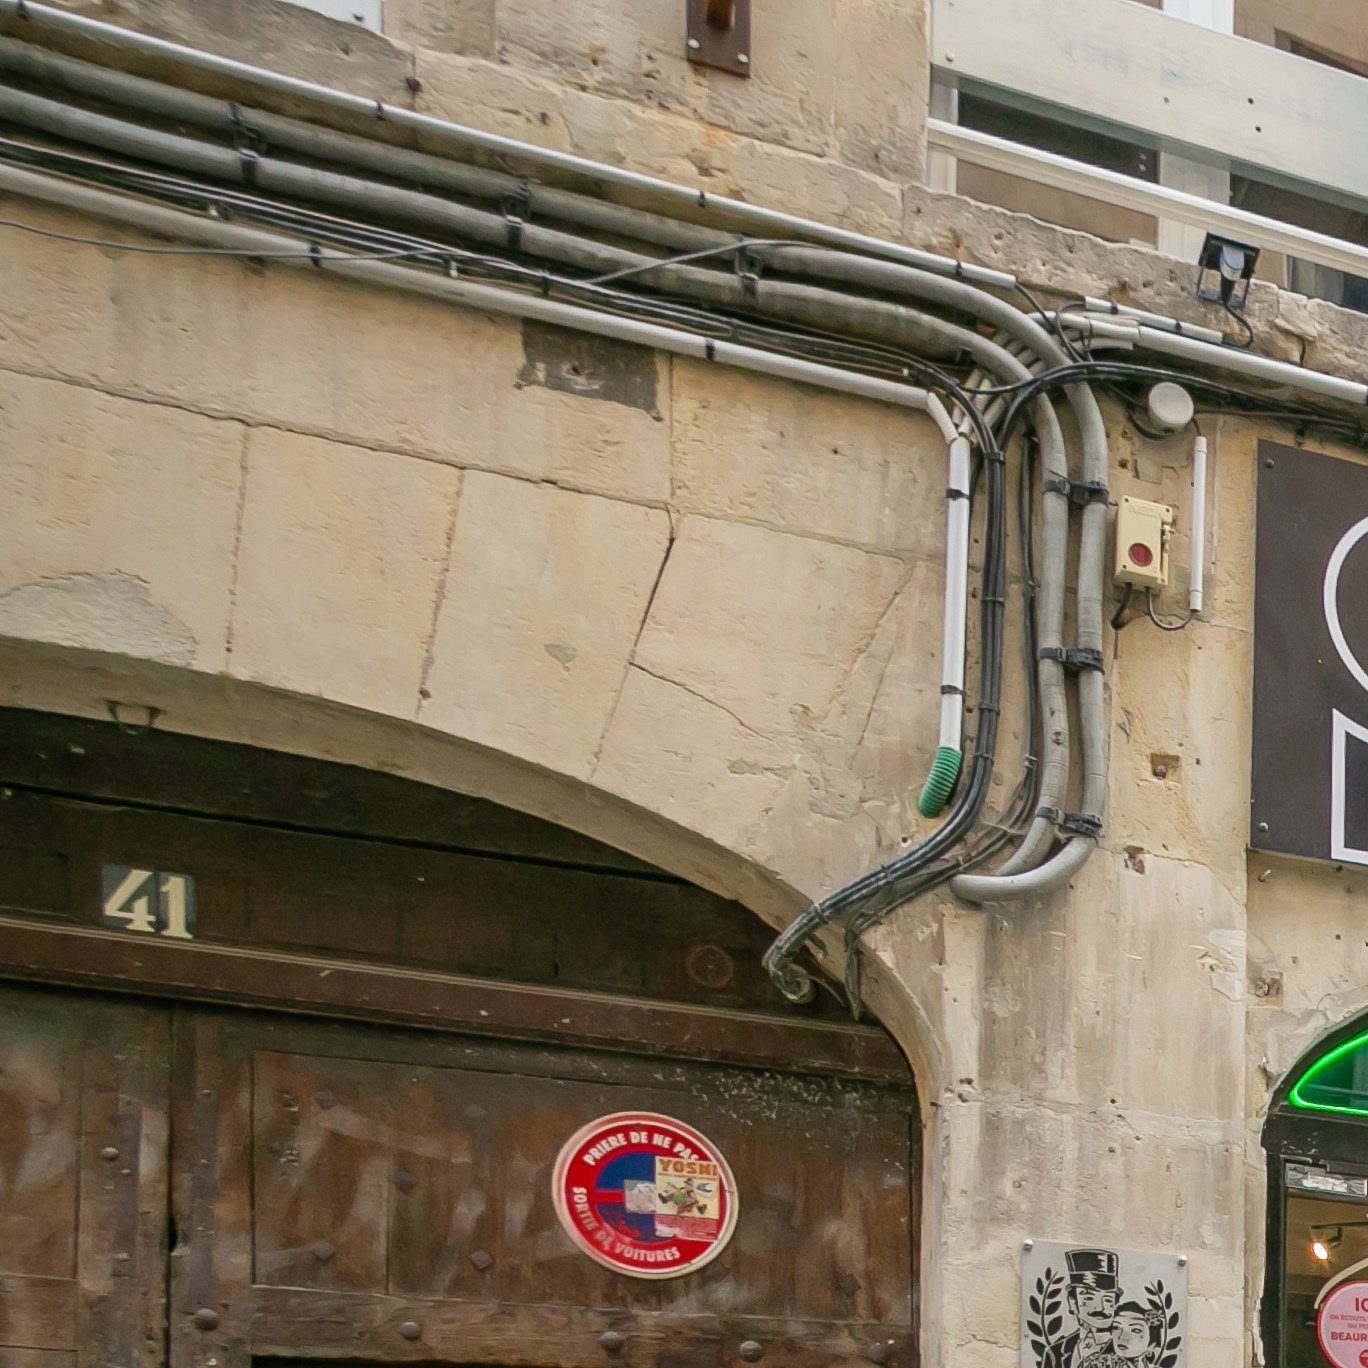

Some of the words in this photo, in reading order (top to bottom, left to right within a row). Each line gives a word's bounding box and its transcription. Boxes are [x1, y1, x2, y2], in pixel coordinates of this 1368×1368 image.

[103, 869, 193, 939] 41
[582, 1132, 628, 1167] PRIERE
[629, 1131, 649, 1144] DE
[652, 1133, 671, 1149] NE
[615, 1242, 681, 1263] VOITURES
